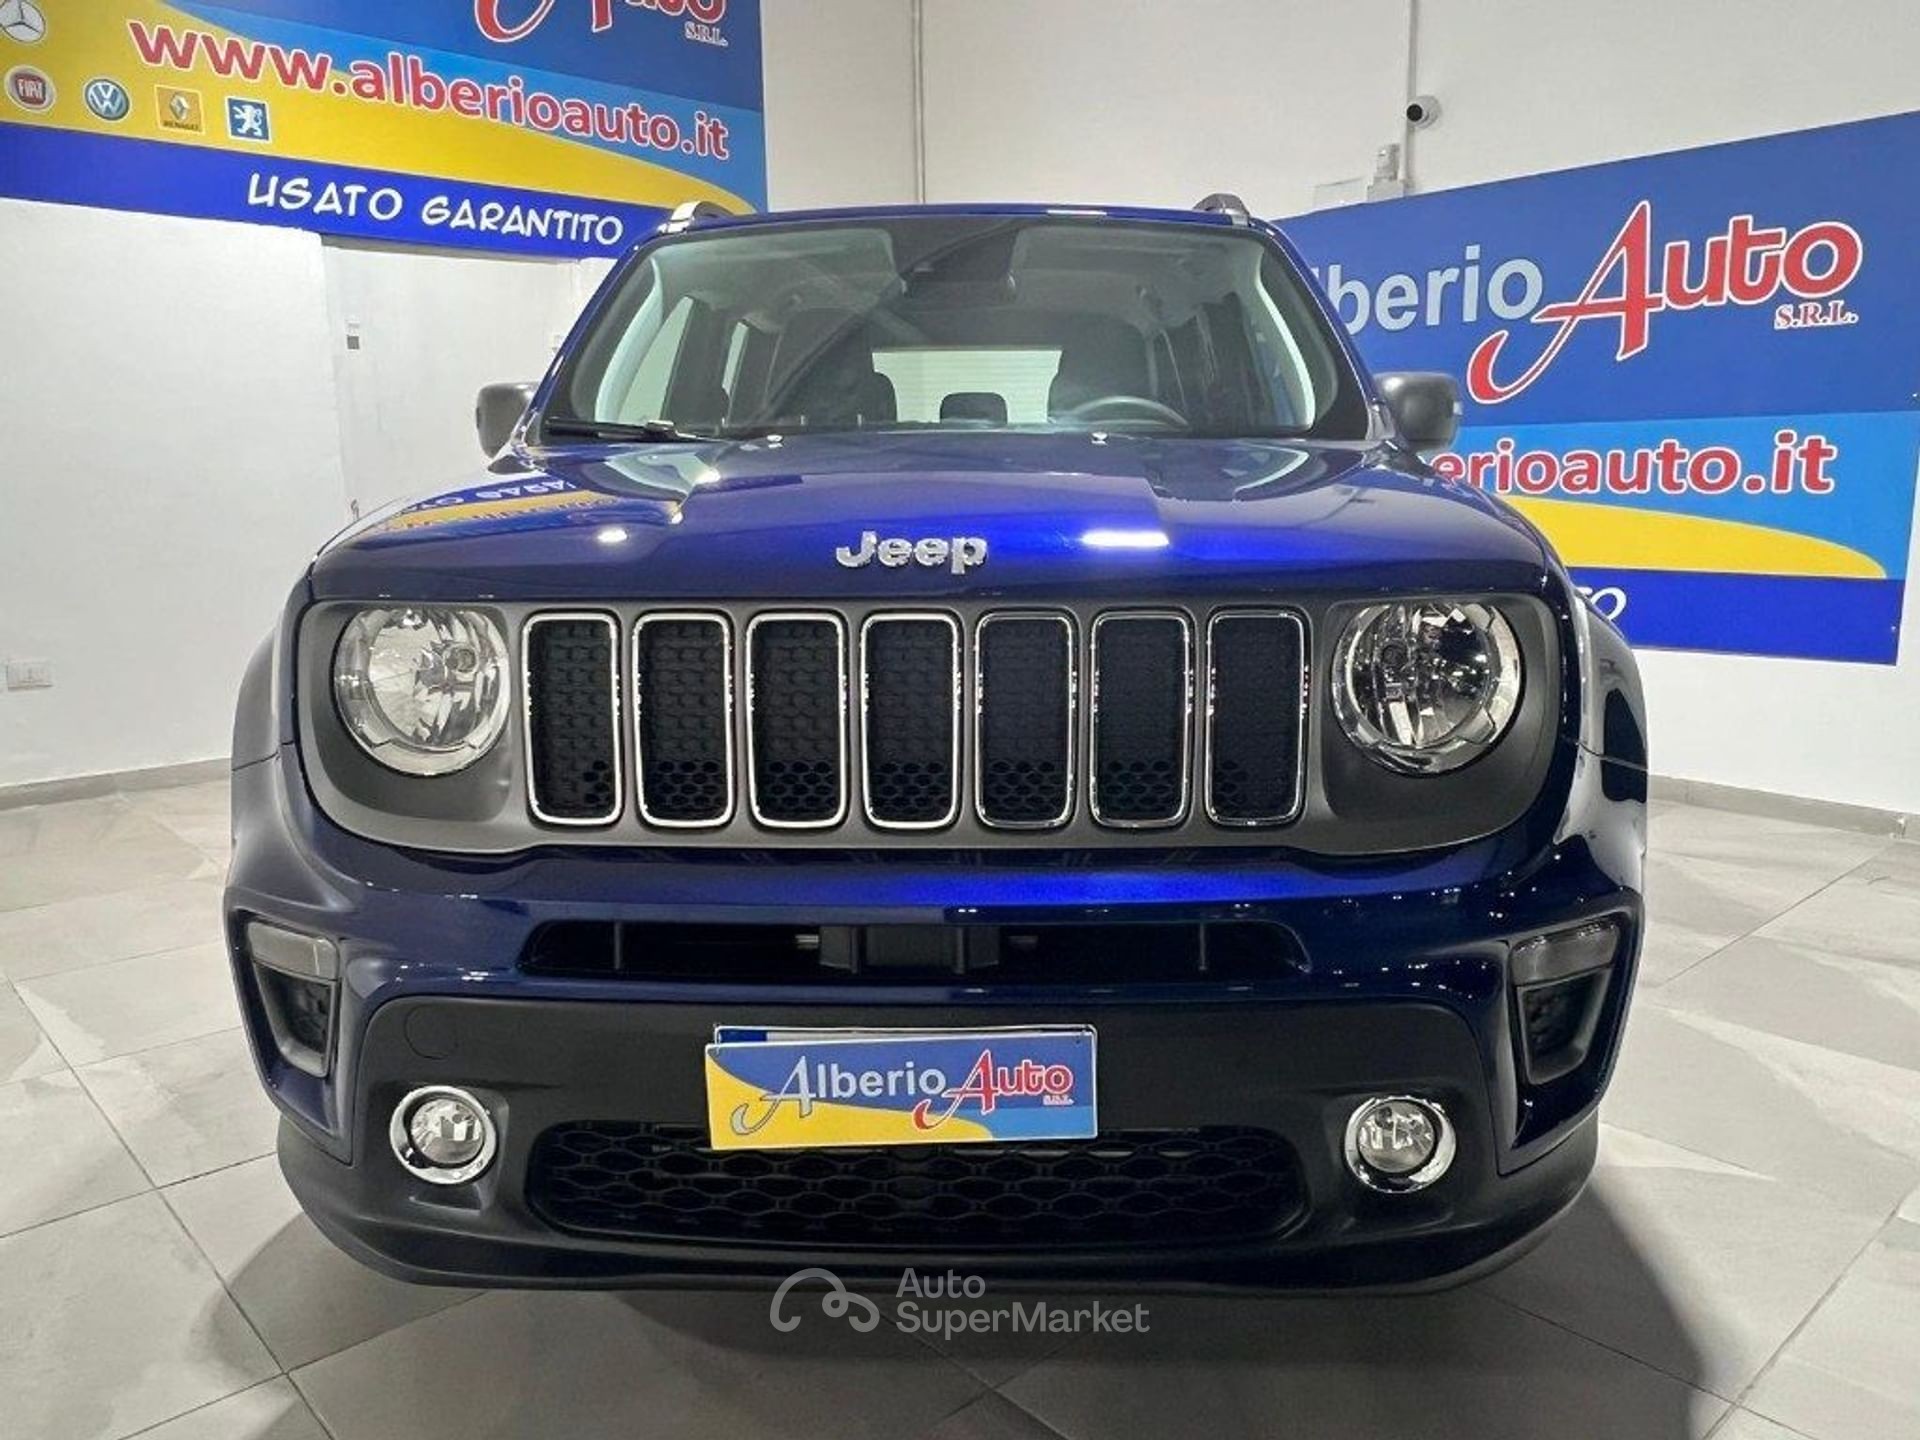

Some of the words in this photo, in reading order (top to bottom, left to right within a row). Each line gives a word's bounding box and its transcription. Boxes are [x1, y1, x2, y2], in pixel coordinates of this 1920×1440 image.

[17, 77, 43, 101] FIAT
[128, 20, 729, 160] www.alberioauto.it
[248, 172, 403, 220] USATO
[421, 195, 624, 245] GARANTITO
[1310, 244, 1543, 336] berio
[1467, 200, 1863, 403] Auto
[1773, 300, 1859, 329] S.R.L.
[836, 531, 988, 575] Jeep
[730, 1055, 947, 1136] Alberio
[912, 1048, 1073, 1131] Auto
